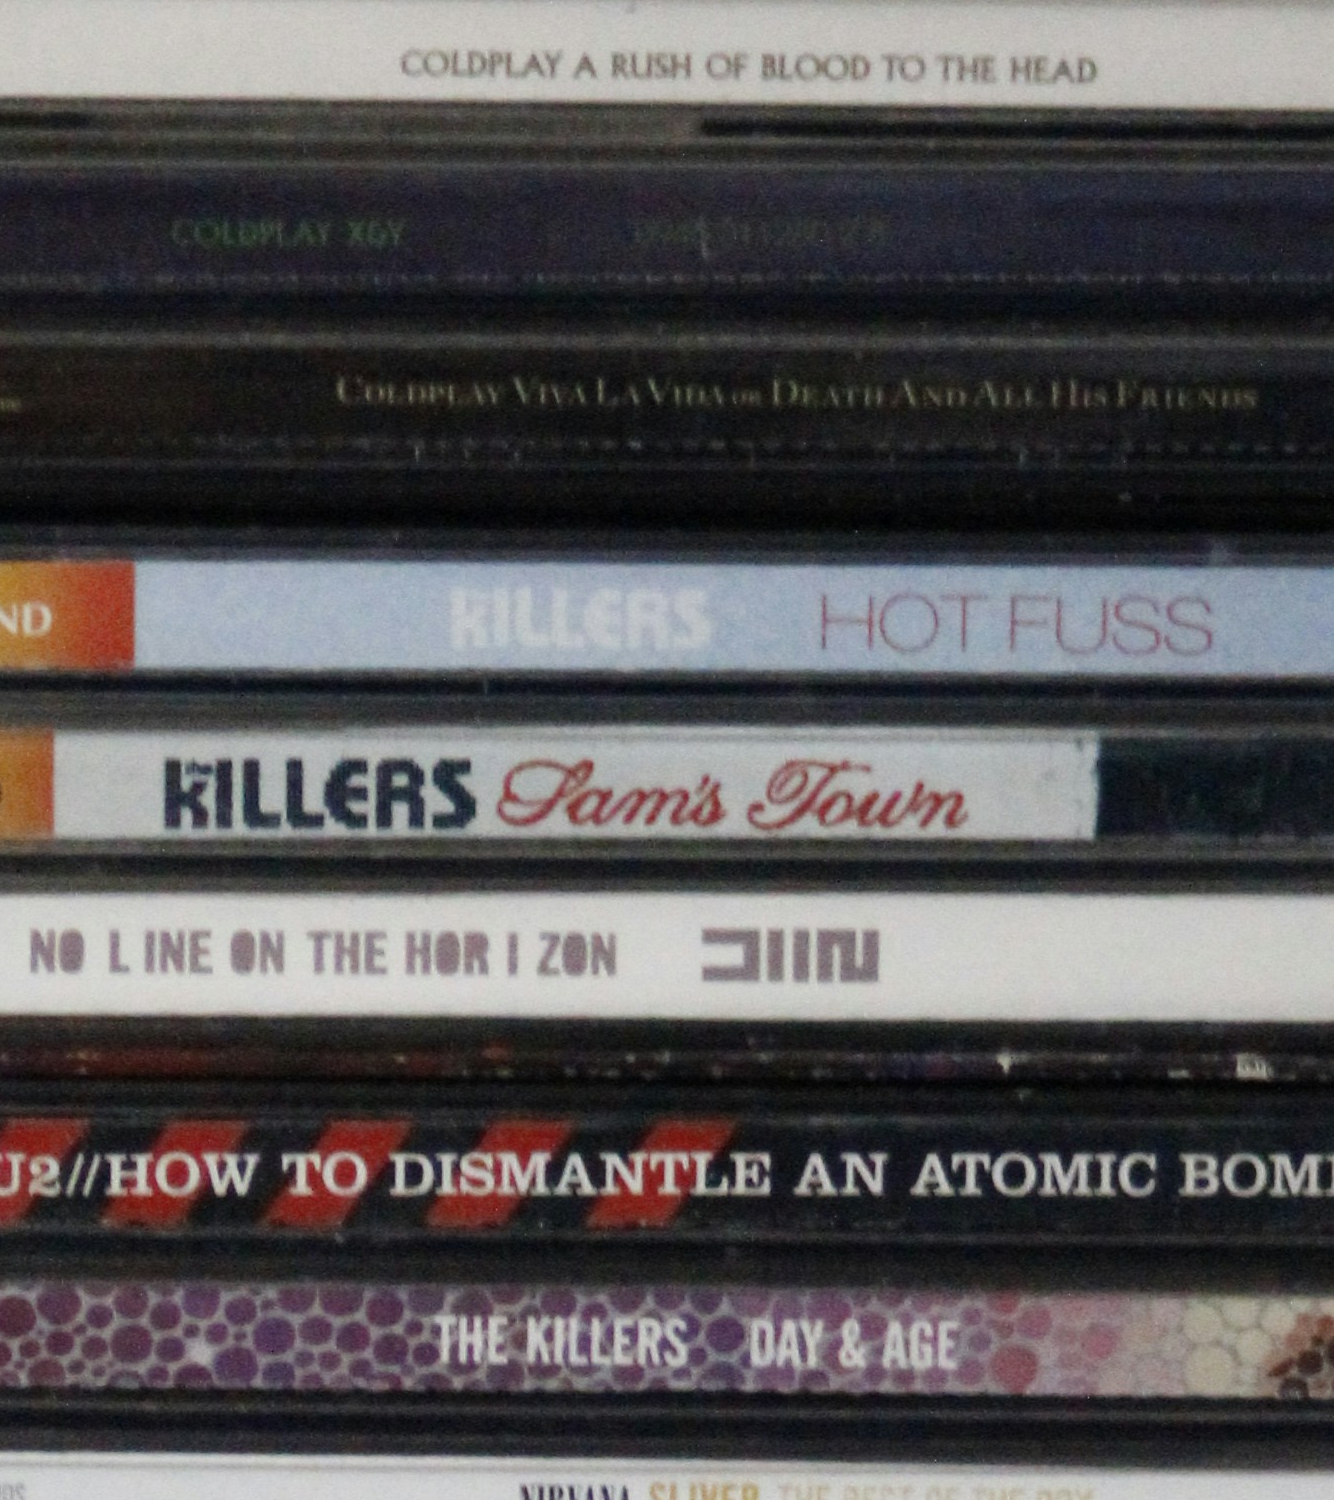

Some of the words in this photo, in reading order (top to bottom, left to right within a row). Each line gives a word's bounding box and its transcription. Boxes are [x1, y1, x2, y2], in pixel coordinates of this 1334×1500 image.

[399, 49, 564, 82] COLDPLAY
[572, 51, 597, 82] A
[610, 51, 691, 83] RUSH
[704, 52, 749, 84] OF
[760, 52, 872, 85] BLOOD
[881, 54, 926, 86] TO
[936, 54, 997, 86] THE
[1009, 55, 1099, 86] HEAD
[169, 217, 330, 250] COLDPLAY
[449, 586, 713, 650] KILLERS
[821, 593, 989, 650] HOT
[1010, 596, 1215, 655] FUSS
[164, 757, 477, 830] KILLERS
[497, 758, 727, 828] Sam's
[749, 758, 969, 832] Town
[29, 929, 84, 975] NO
[230, 928, 285, 975] ON
[308, 928, 388, 975] THE
[281, 1152, 367, 1199] TO
[388, 1151, 771, 1198] DISMANTLE
[794, 1153, 886, 1196] AN
[910, 1153, 1157, 1198] ATOMIC
[435, 1316, 510, 1367] THE
[525, 1316, 689, 1368] KILLERS
[750, 1319, 824, 1368] DAY
[838, 1324, 868, 1368] &
[882, 1320, 959, 1369] AGE
